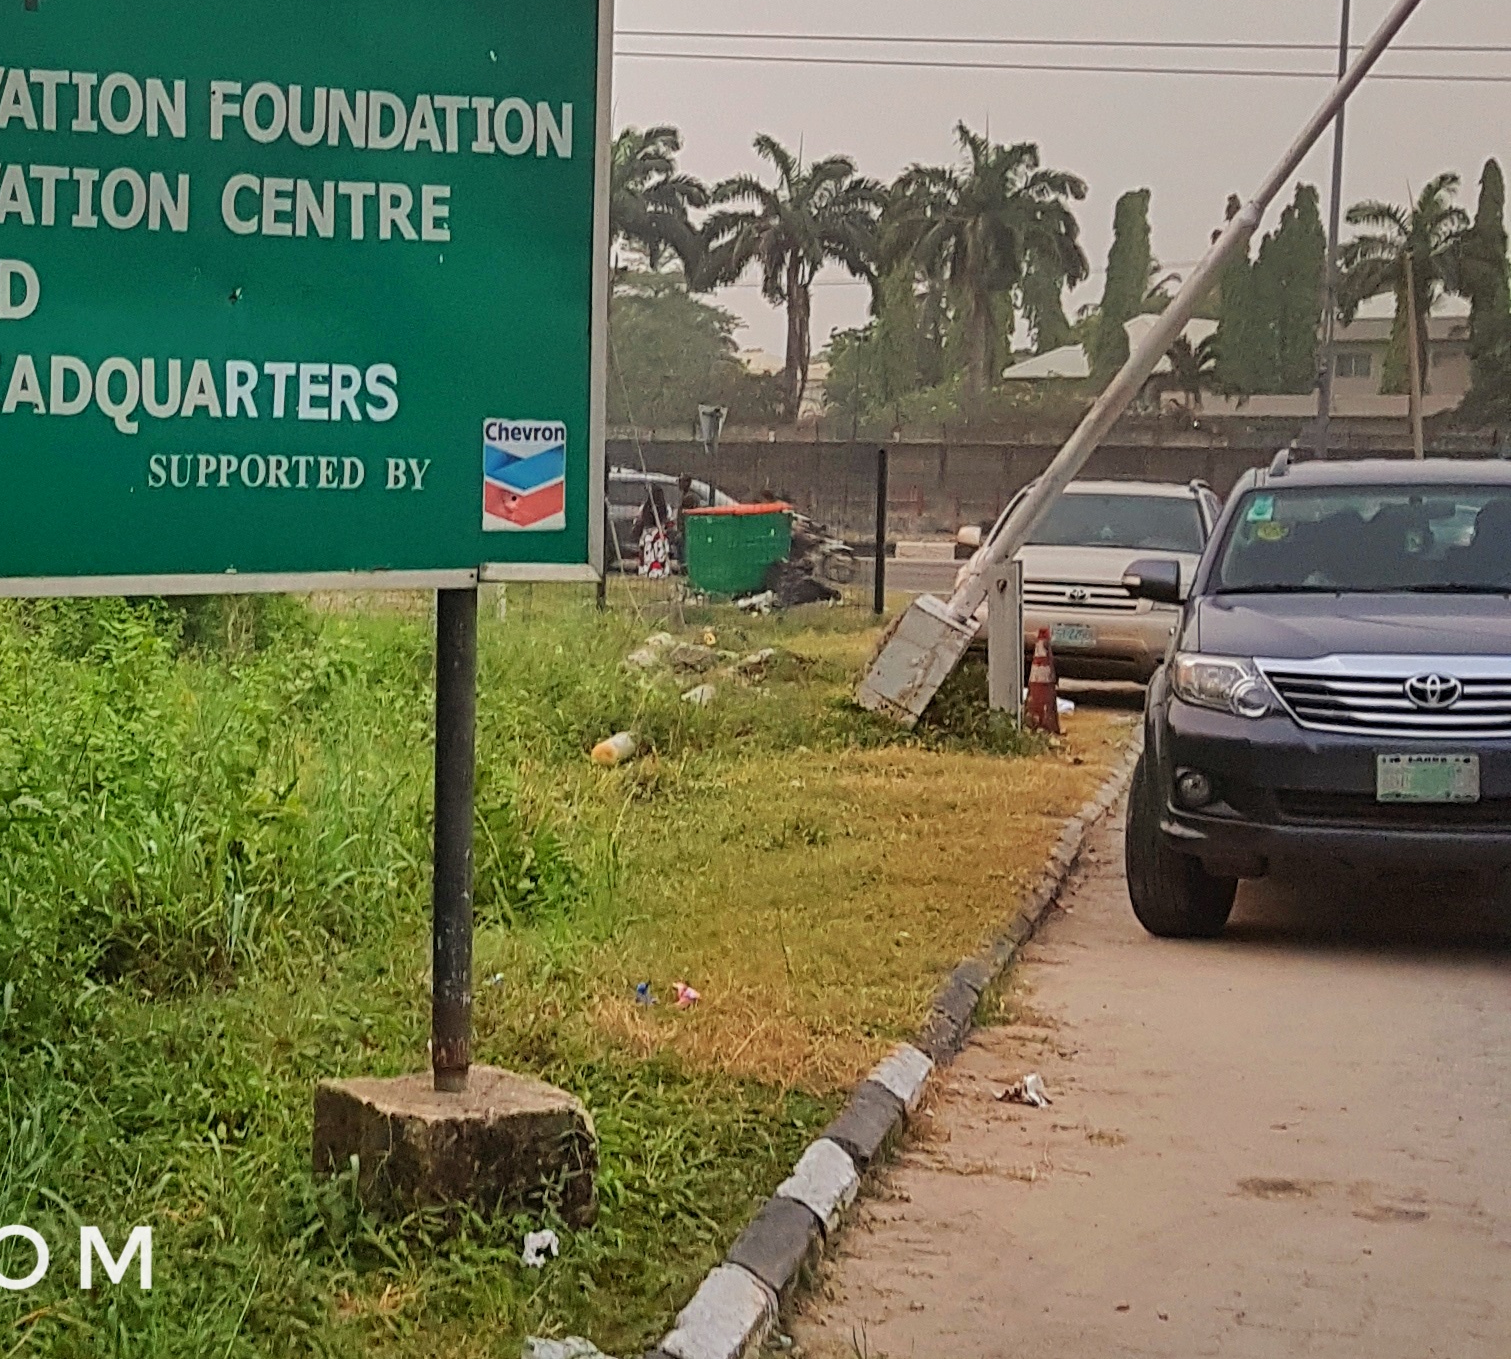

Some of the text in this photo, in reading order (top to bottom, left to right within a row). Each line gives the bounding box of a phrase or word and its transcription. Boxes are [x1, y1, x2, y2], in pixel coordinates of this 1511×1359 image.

[210, 80, 573, 159] FOUNDATION
[221, 173, 451, 242] CENTRE
[485, 421, 566, 442] Chevron
[148, 454, 431, 491] SUPPORTED BY
